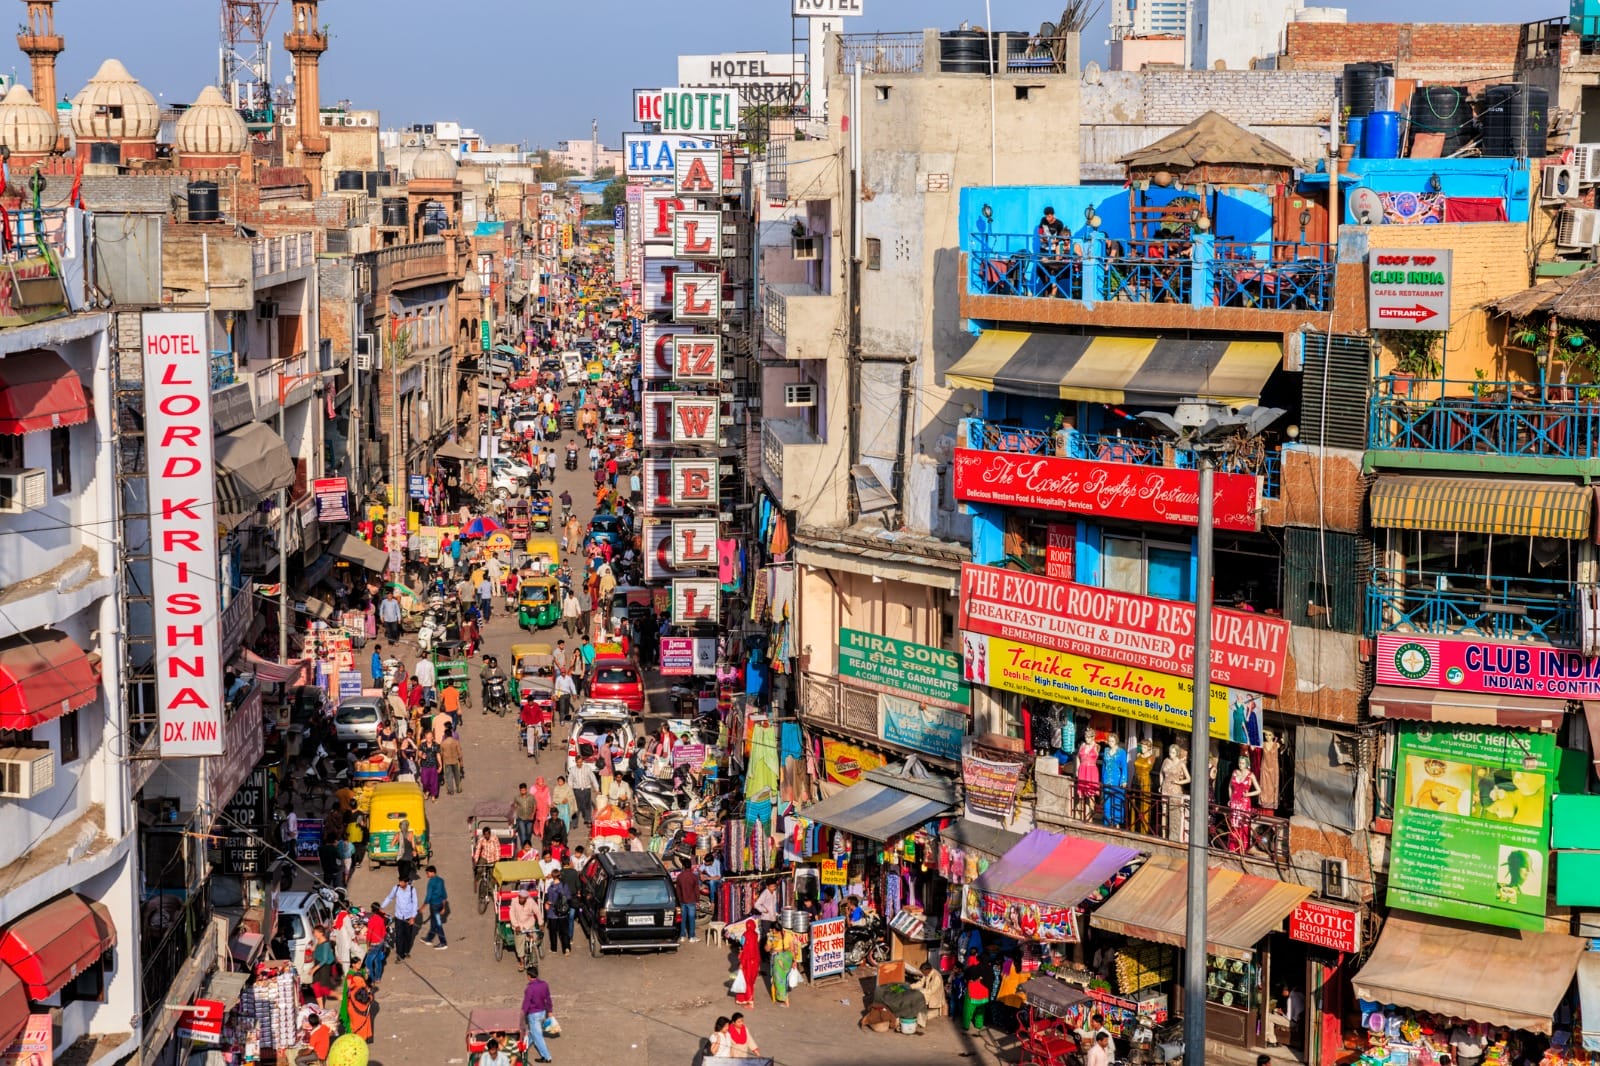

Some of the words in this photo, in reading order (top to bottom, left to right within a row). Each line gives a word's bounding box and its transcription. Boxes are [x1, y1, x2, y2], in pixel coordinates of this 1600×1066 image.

[710, 60, 770, 78] HOTEL
[663, 92, 736, 130] HOTEL
[628, 140, 714, 170] HA
[1377, 255, 1408, 265] ROOF
[1413, 256, 1436, 266] TOP
[1371, 270, 1406, 285] CLUB
[1407, 271, 1445, 286] INDIA
[1380, 309, 1428, 317] ENTRANCE
[148, 335, 199, 355] HOTEL
[677, 343, 714, 376] IZ
[159, 363, 202, 478] LORD
[982, 455, 1014, 486] The
[1016, 460, 1080, 496] Exotic
[1083, 469, 1138, 510] Rooftop
[966, 489, 991, 499] Delicious
[992, 491, 1014, 501] Western
[1016, 493, 1029, 502] Food
[1030, 495, 1035, 503] &
[1036, 495, 1067, 508] Hospitality
[1068, 500, 1093, 510] Services
[677, 405, 713, 620] WELL
[161, 498, 210, 709] KRISHNA
[965, 568, 999, 599] THE
[1002, 575, 1065, 612] EXOTIC
[1067, 587, 1154, 629] ROOFTOP
[969, 602, 1046, 628] BREAKFAST
[1049, 618, 1095, 640] LUNCH
[1099, 629, 1110, 642] &
[1113, 632, 1171, 654] DINNER
[1227, 652, 1276, 678] WI-FI)
[1001, 626, 1055, 647] REMEMBER
[1057, 639, 1070, 649] US
[1071, 643, 1091, 654] FOR
[1093, 647, 1147, 665] DELICIOUS
[1149, 656, 1178, 672] FOOD
[850, 633, 897, 655] HIRA
[902, 645, 959, 669] SONS
[1465, 645, 1531, 675] CLUB
[849, 658, 878, 673] READY
[880, 665, 905, 679] MADE
[907, 672, 959, 692] GARMENTS
[1007, 647, 1073, 679] Tanika
[1083, 663, 1166, 699] Fashion
[1483, 674, 1534, 690] INDIAN
[855, 670, 860, 678] A
[861, 672, 900, 687] COMPLETE
[902, 681, 929, 695] FAMILY
[929, 688, 951, 699] SHOP
[1003, 668, 1021, 679] Deals
[1022, 673, 1031, 682] In:
[1034, 675, 1051, 686] High
[1053, 680, 1079, 692] Fashion
[1080, 685, 1106, 698] Sequins
[1108, 691, 1143, 707] Garments
[1144, 699, 1163, 713] Belly
[1164, 704, 1188, 717] Dance
[1101, 702, 1117, 711] Pahar
[163, 722, 187, 742] DX.
[192, 721, 217, 741] INN
[1452, 729, 1483, 741] VEDIC
[1485, 733, 1531, 750] HEALERS
[1440, 740, 1478, 750] AYURVEDIC
[1480, 745, 1511, 755] THERAPY
[229, 790, 259, 806] OOF
[232, 809, 255, 825] TOP
[1406, 825, 1432, 834] Pharmacy
[1508, 826, 1540, 835] Consultation
[225, 837, 263, 847] RESTAURANT
[231, 850, 258, 860] FREE
[232, 862, 258, 872] WI-FI
[828, 921, 844, 935] SONS
[1294, 908, 1353, 932] EXOTIC
[1293, 929, 1352, 950] RESTAURANT
[1299, 922, 1346, 940] ROOFTOP
[814, 939, 830, 953] हीरा
